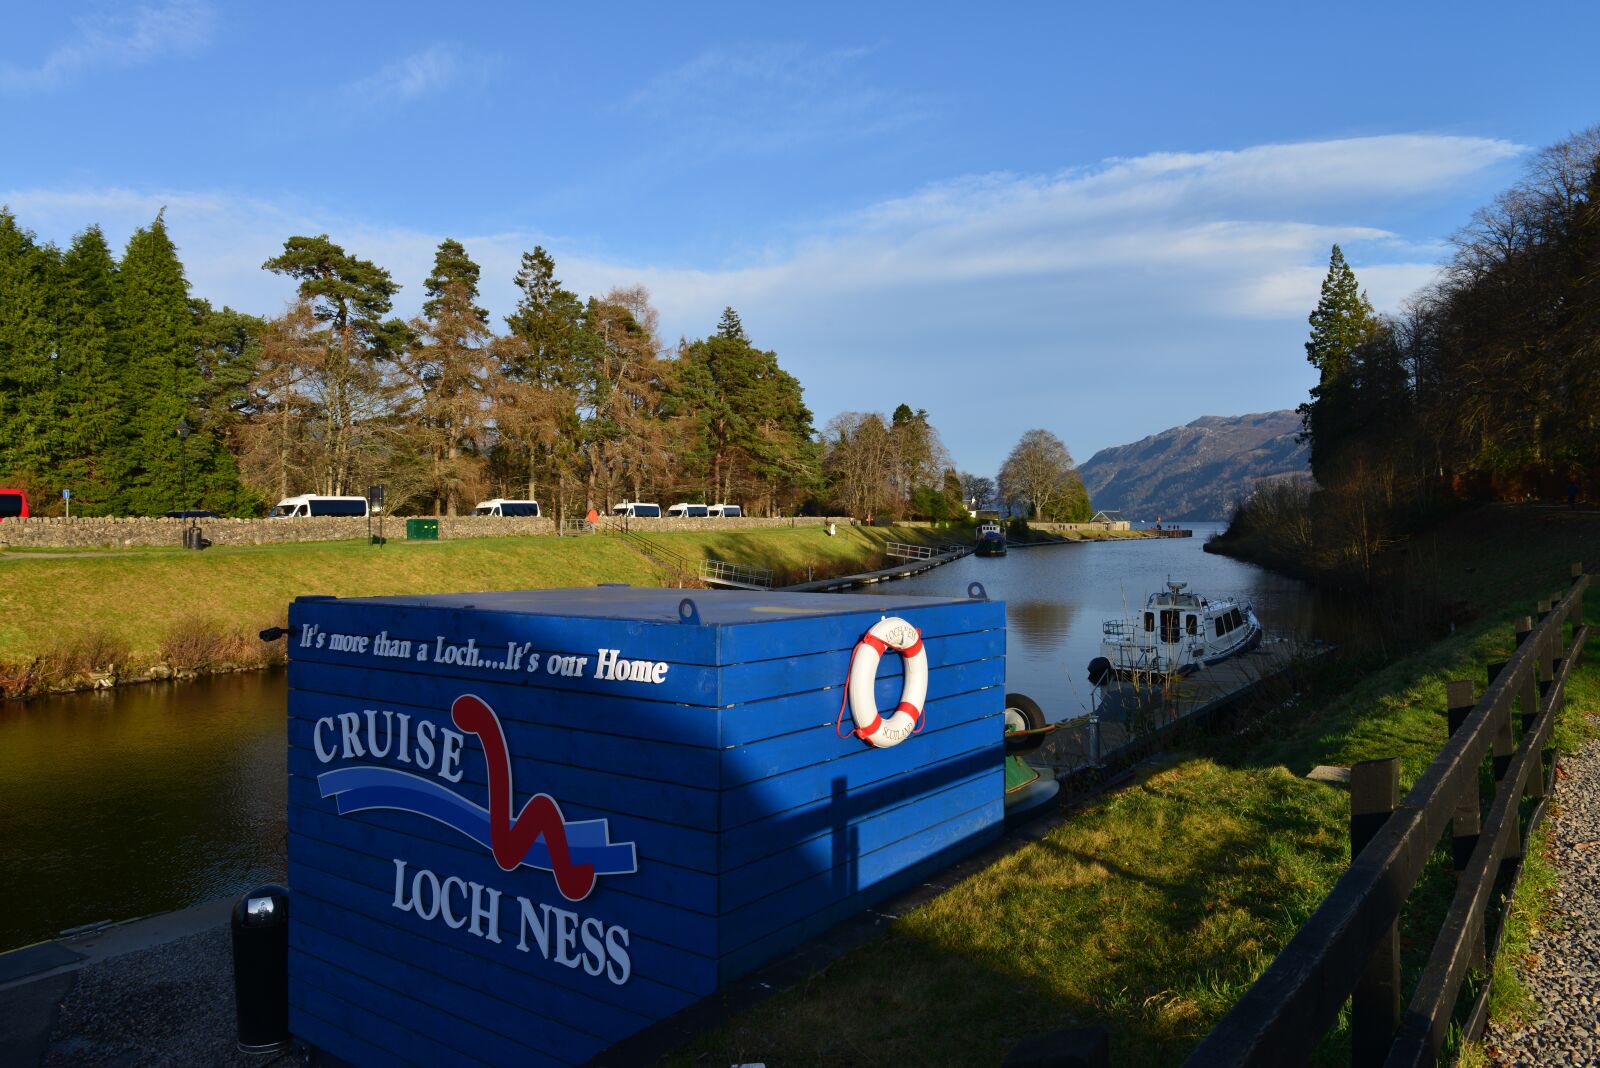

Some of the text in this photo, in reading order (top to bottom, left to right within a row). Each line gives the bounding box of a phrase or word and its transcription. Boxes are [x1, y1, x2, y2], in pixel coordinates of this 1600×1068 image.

[300, 623, 326, 648] It's
[329, 633, 369, 653] more
[373, 630, 411, 658] than
[417, 643, 428, 661] a
[547, 654, 587, 677] our
[594, 648, 669, 684] Home
[313, 709, 464, 783] CRUISE
[392, 858, 631, 985] LOCH NESS
